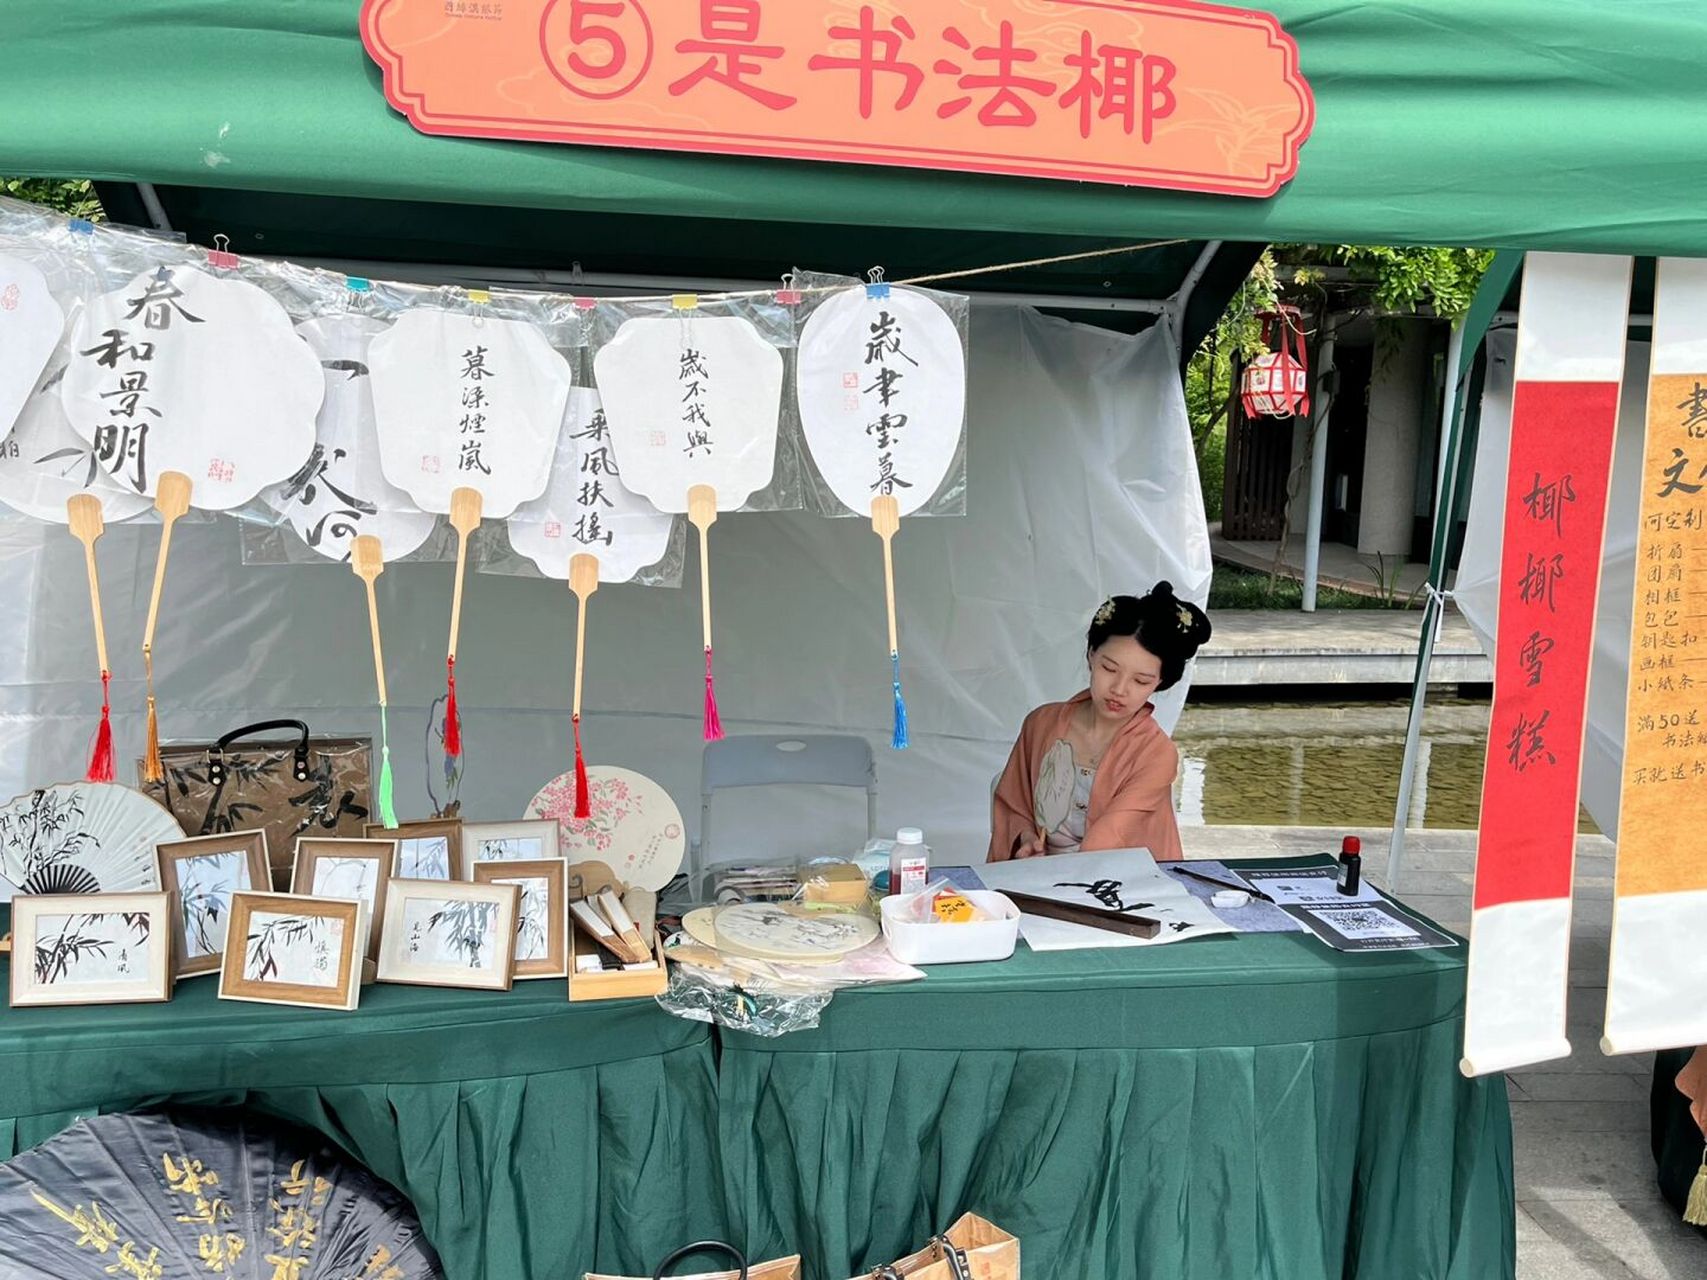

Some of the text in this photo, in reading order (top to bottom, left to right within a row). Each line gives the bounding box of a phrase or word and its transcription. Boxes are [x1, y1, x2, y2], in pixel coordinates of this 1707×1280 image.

[80, 266, 206, 493] 春和景明
[1657, 447, 1707, 498] 文
[1647, 542, 1682, 561] 折扇
[1645, 609, 1679, 628] 包包
